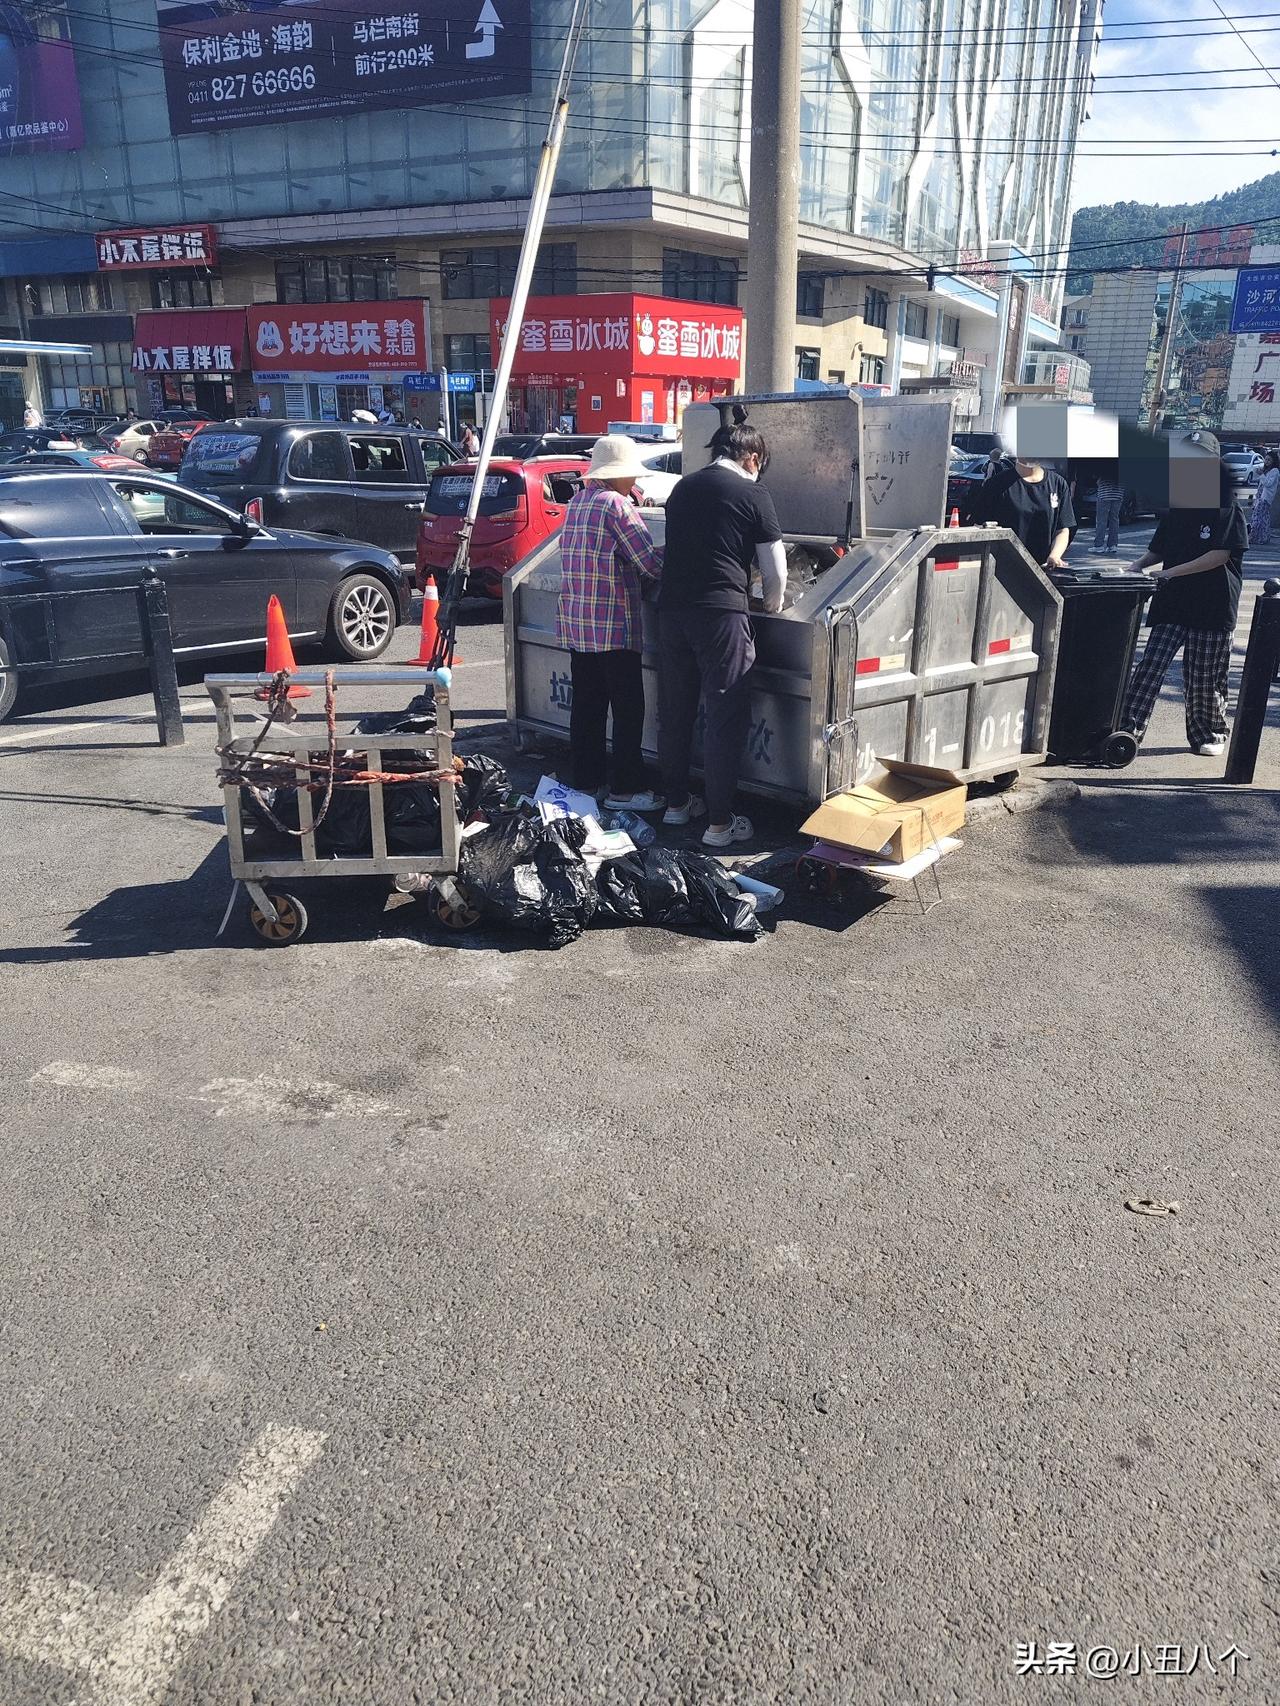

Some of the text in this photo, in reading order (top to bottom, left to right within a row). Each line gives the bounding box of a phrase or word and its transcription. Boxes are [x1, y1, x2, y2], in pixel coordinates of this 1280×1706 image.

[182, 20, 313, 68] 保利金地·海韵
[353, 12, 419, 43] 马栏南街
[355, 43, 434, 76] 前行200米
[187, 64, 316, 104] 0411 827 66666
[288, 320, 382, 356] 好想来
[383, 318, 416, 338] 零食
[521, 317, 629, 352] 蜜雪冰城
[657, 317, 740, 360] 蜜雪冰城
[132, 345, 234, 371] 小木屋拌饭
[385, 337, 416, 356] 乐园
[979, 709, 1028, 752] 018
